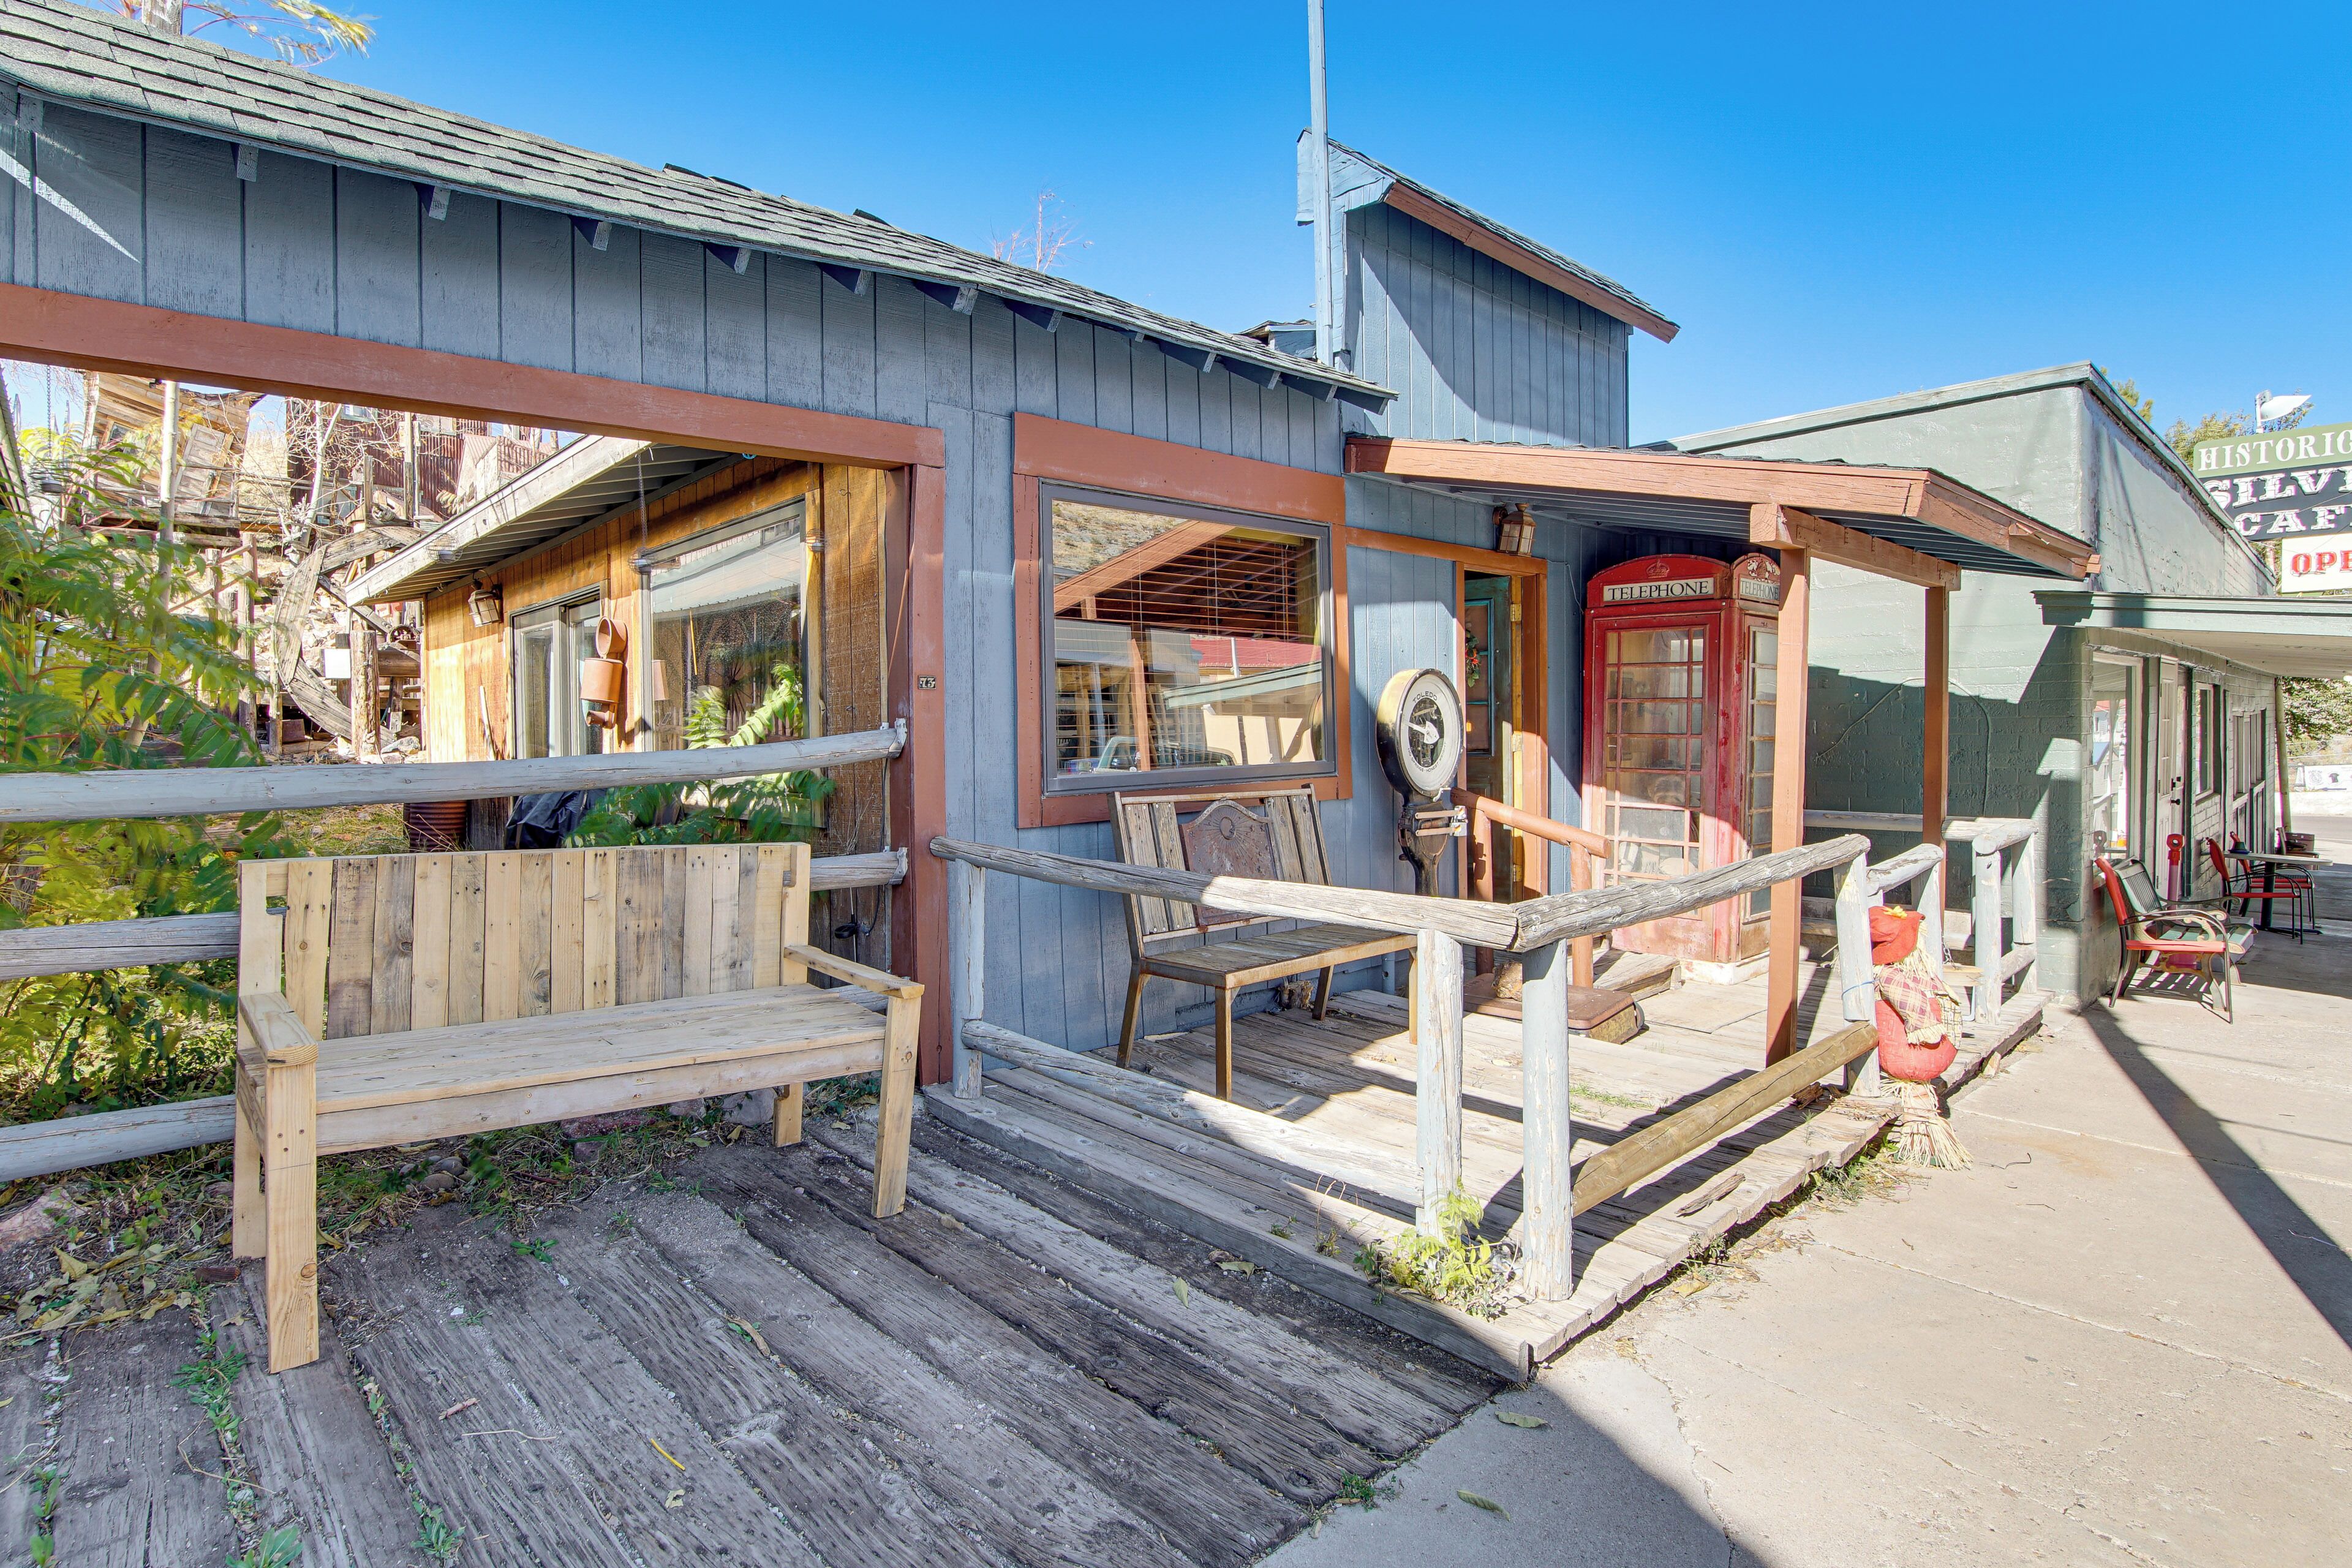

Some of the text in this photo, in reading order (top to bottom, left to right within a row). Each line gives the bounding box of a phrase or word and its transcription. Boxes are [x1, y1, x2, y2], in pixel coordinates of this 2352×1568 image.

[2198, 429, 2352, 471] HISTORIC
[2234, 503, 2352, 537] CAF
[1608, 581, 1709, 600] TELEPHONE
[1741, 580, 1779, 600] TELEPHONE
[920, 677, 935, 688] 73
[1412, 691, 1438, 703] TOLEDO
